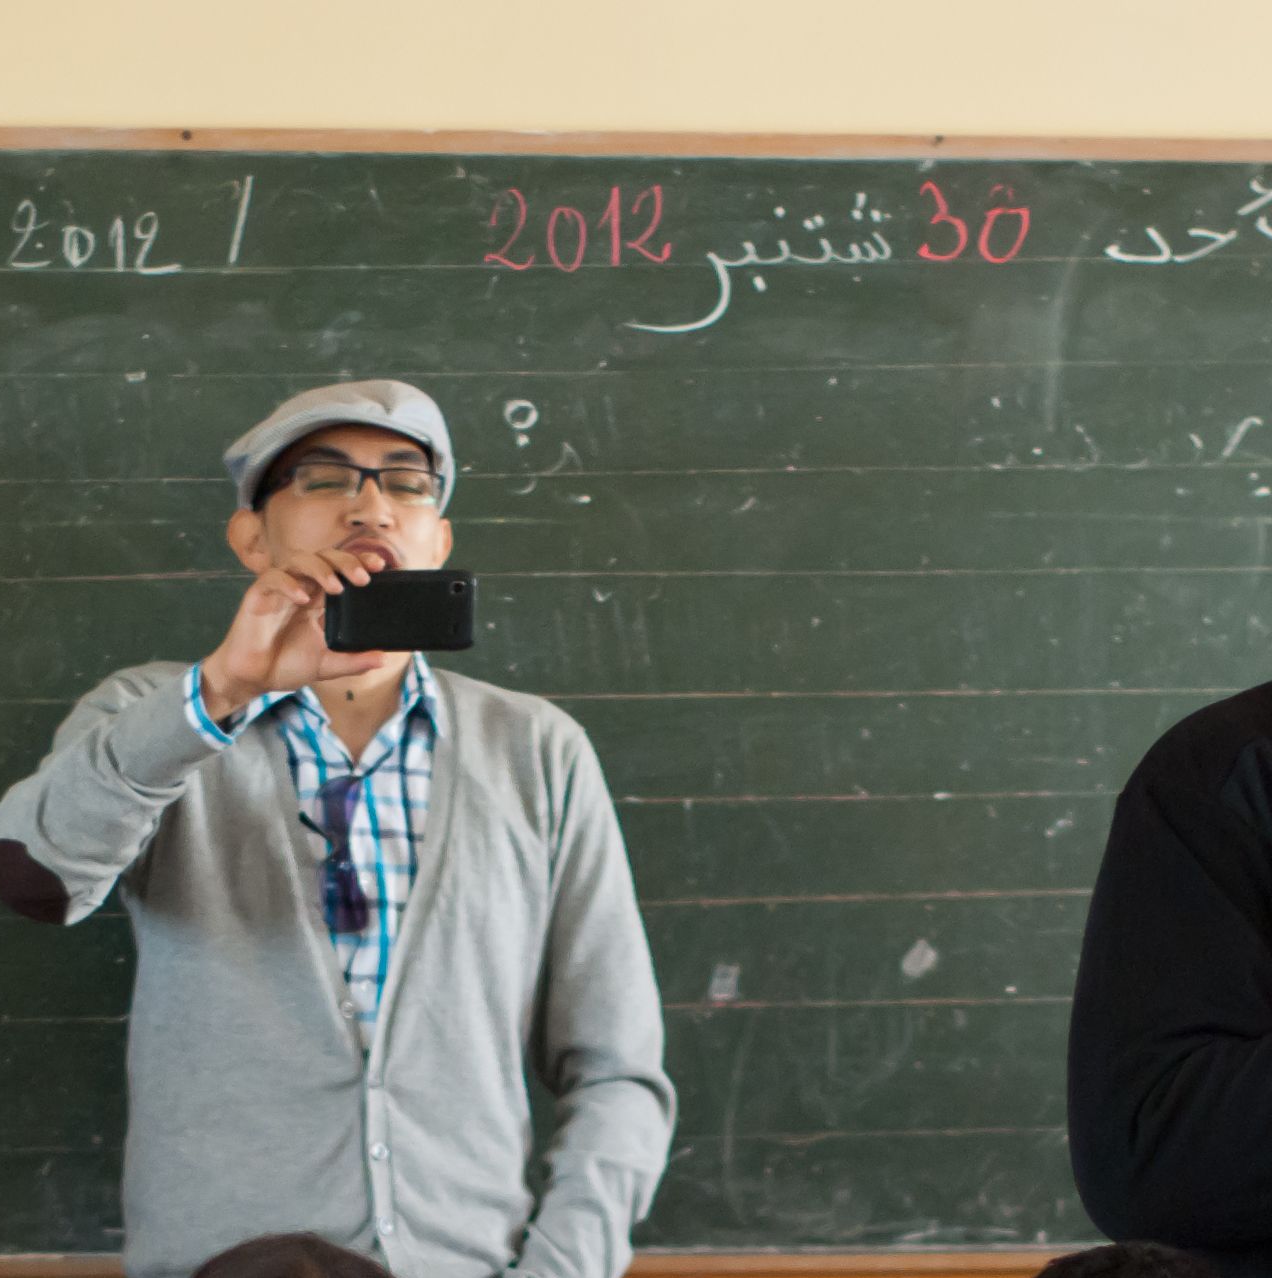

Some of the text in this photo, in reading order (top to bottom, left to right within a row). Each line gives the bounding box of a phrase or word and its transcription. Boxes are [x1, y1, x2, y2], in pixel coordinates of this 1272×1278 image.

[6, 199, 182, 275] 2012
[484, 185, 672, 272] 2012
[916, 179, 1031, 264] 30
